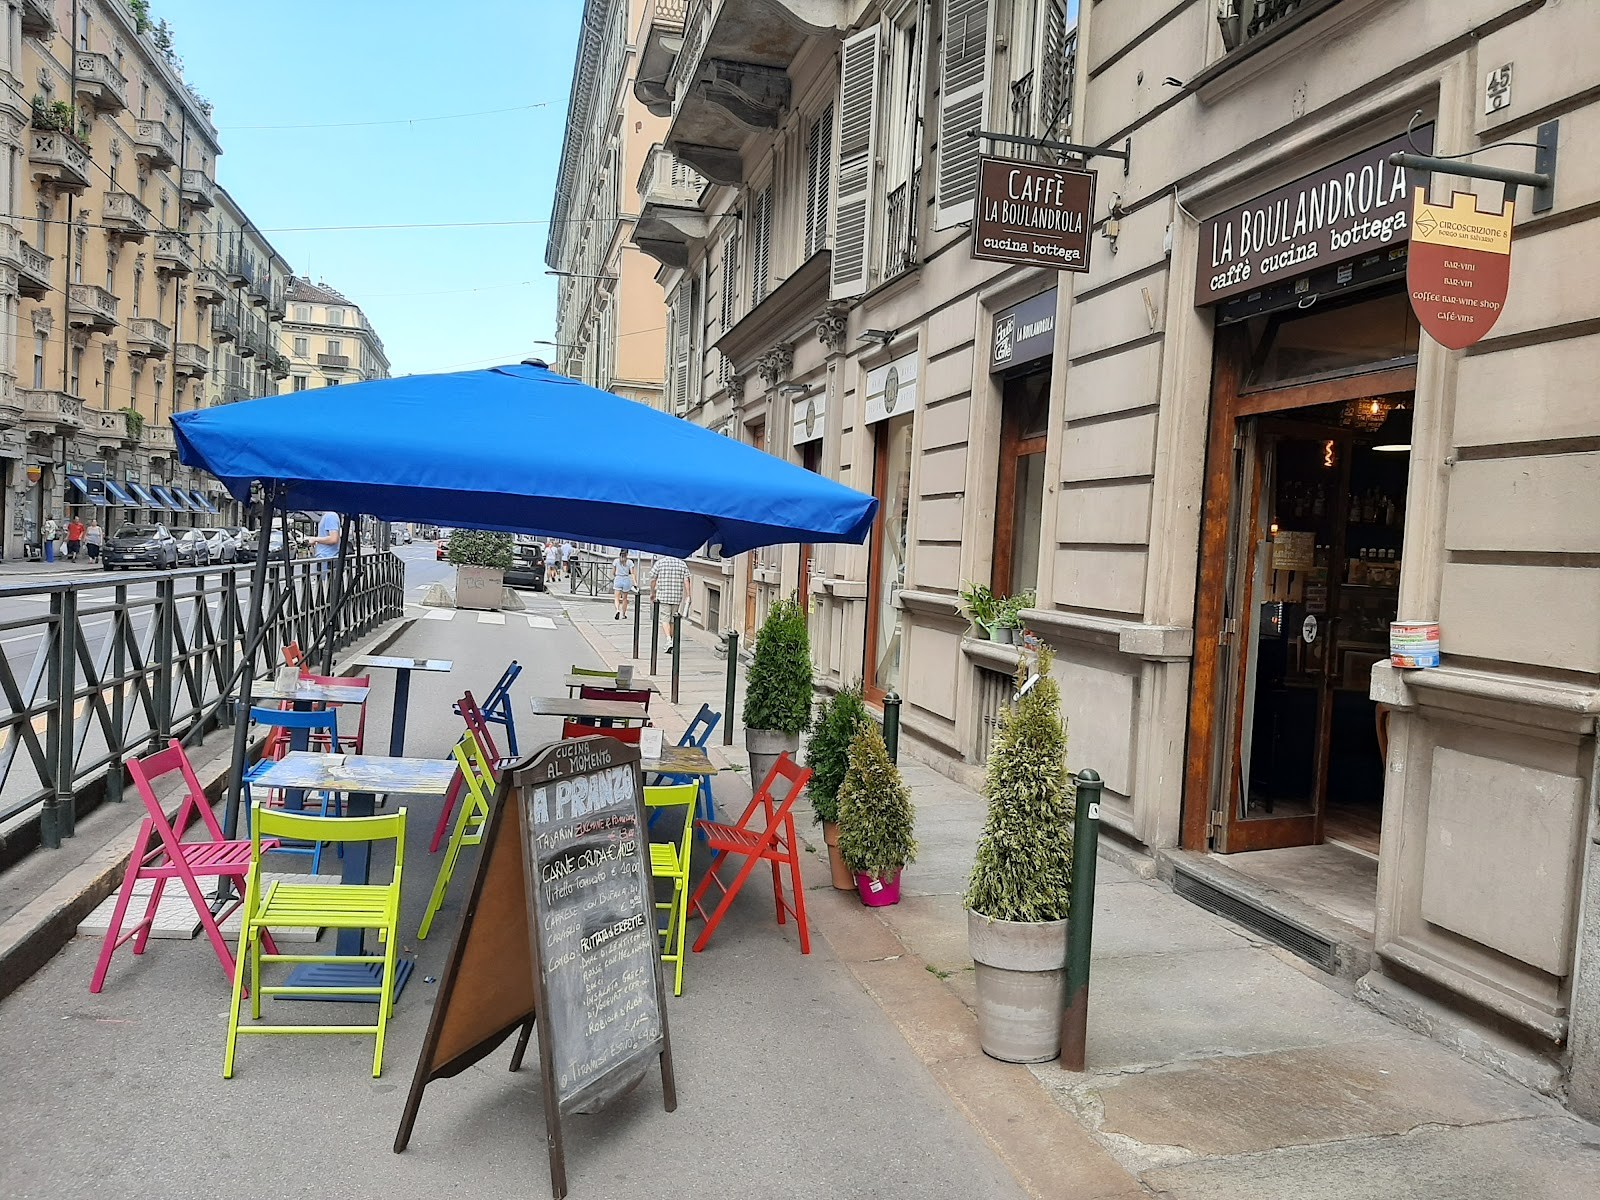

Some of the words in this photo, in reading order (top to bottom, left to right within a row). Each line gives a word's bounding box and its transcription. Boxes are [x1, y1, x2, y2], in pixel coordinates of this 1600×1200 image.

[1488, 65, 1510, 92] 45
[1008, 169, 1065, 206] CAFFÈ
[984, 196, 998, 223] LA
[1002, 200, 1082, 234] BOULANDROLA
[1212, 222, 1233, 268] LA
[1239, 151, 1407, 258] BOULANDROLA
[1439, 220, 1502, 237] CIRCOSCRIZIONE
[983, 238, 1029, 253] cucina
[1033, 241, 1081, 261] bottega
[1210, 259, 1251, 291] caffè
[1260, 241, 1319, 274] cucina
[1330, 210, 1407, 251] bottega
[548, 762, 562, 778] AL
[569, 749, 612, 774] MOMENTO
[556, 742, 590, 758] CUCINA
[533, 787, 549, 824] A
[556, 764, 633, 820] PRANZO
[542, 854, 576, 884] CARNE
[577, 848, 607, 870] CRUDA
[606, 844, 616, 860] €
